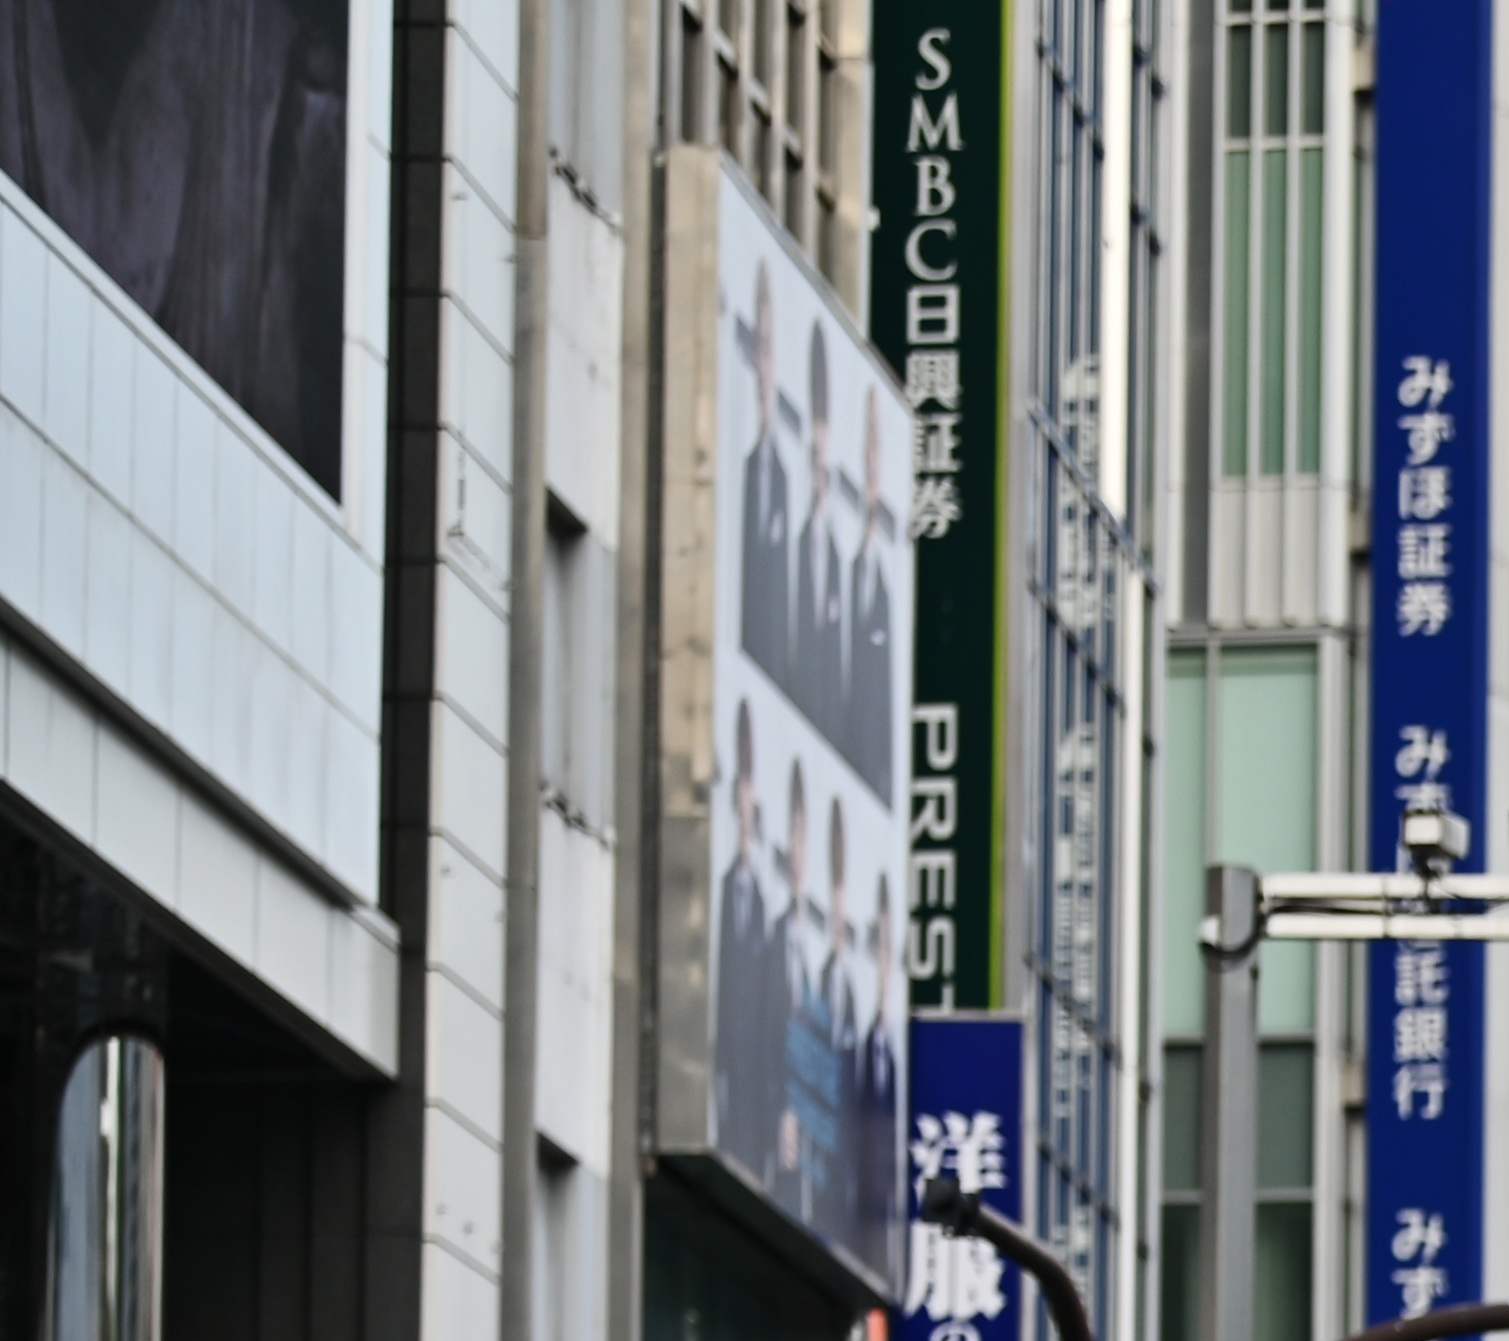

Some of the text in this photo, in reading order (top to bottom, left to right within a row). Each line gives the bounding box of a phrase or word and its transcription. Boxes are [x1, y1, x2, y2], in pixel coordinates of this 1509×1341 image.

[904, 27, 963, 541] SMBC日興証券
[1396, 356, 1454, 637] みずほ証券
[908, 704, 957, 1011] PREST
[1391, 727, 1453, 1121] みず託銀行
